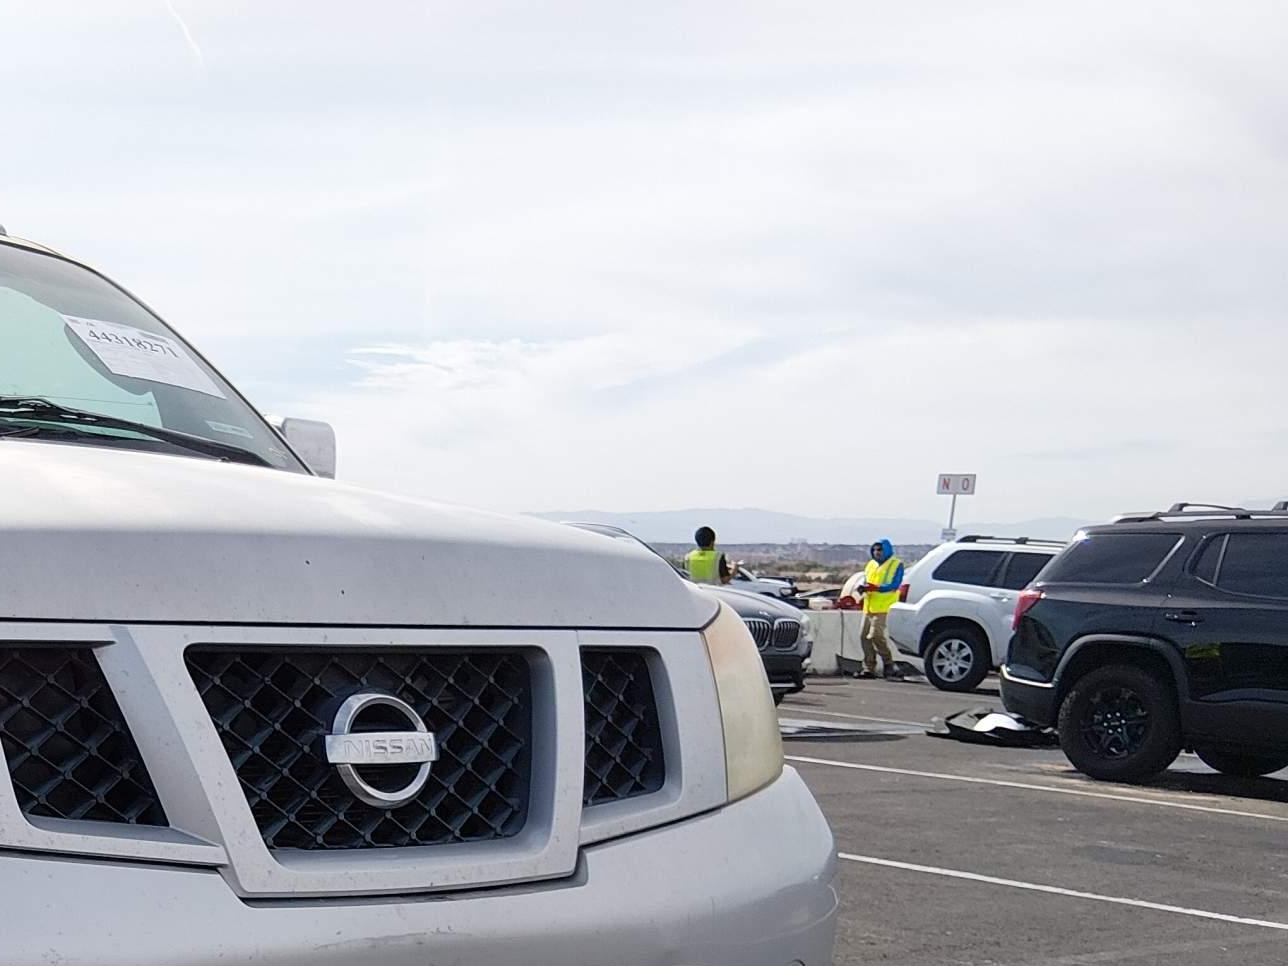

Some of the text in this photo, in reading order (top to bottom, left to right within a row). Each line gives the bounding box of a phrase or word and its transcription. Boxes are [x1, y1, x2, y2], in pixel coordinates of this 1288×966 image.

[88, 329, 180, 358] 44318271
[942, 477, 951, 490] N
[343, 738, 433, 758] NISSAN
